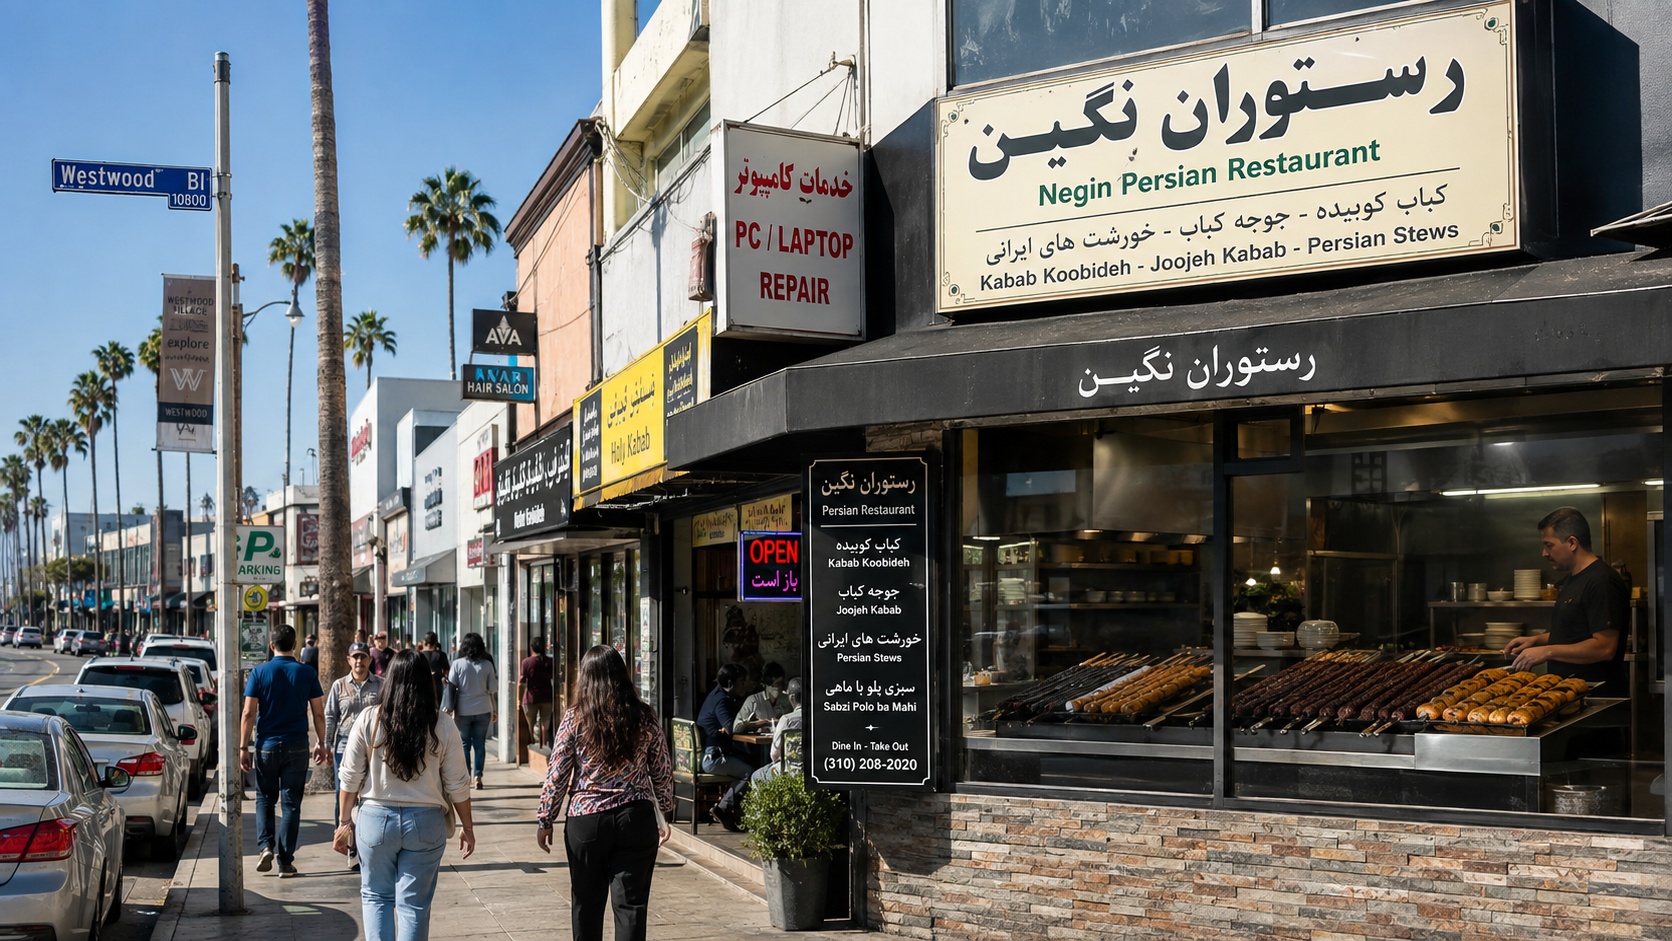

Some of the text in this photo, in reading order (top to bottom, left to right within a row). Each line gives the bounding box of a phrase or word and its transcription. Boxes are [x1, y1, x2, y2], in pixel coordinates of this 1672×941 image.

[967, 55, 1466, 181] رستوران نگین
[61, 164, 155, 188] Westwood
[734, 158, 854, 199] خدمات کامپیوتر
[1039, 139, 1381, 208] Negin Persian Restaurant
[172, 193, 206, 207] 10800
[1316, 191, 1386, 223] کوبیده
[1397, 183, 1448, 215] کباب
[1179, 212, 1226, 242] کباب
[1234, 210, 1290, 233] جوجه
[735, 220, 854, 259] PC / LAPTOP
[1039, 233, 1075, 259] های
[1082, 222, 1155, 250] خورشت
[980, 270, 1037, 291] Kabab
[1043, 259, 1131, 284] Koobideh
[1150, 250, 1216, 273] Joojeh
[1223, 241, 1287, 264] Kabab
[1308, 232, 1386, 255] Persian
[1393, 224, 1459, 245] Stews
[986, 237, 1032, 266] ایرانی
[760, 271, 830, 305] REPAIR
[167, 336, 209, 351] explore
[485, 327, 522, 346] AVA
[1078, 344, 1317, 398] رستوران نگین
[467, 382, 529, 394] HAIR SALON
[627, 426, 650, 458] Kabab
[821, 470, 916, 496] رستوران نگین
[822, 504, 915, 516] Persian Restaurant
[243, 531, 275, 562] P
[749, 539, 799, 564] OPEN
[836, 538, 901, 554] کباب کوبیده
[238, 564, 281, 575] ARKING
[828, 557, 910, 568] Kabab Koobideh
[751, 570, 798, 592] باز است
[838, 585, 900, 600] جوجه کباب
[836, 605, 902, 617] Joojeh Kabab
[817, 632, 922, 648] خورشت های ایرانی
[837, 653, 902, 662] Persian Stews
[825, 680, 916, 697] سبزی پلو با ماهی
[823, 701, 917, 712] Sabzi Polo ba Mahi
[832, 741, 851, 750] Dine
[854, 741, 862, 750] In
[870, 741, 890, 751] Take
[892, 742, 909, 751] Out
[824, 757, 918, 771] (310) 208-2020
